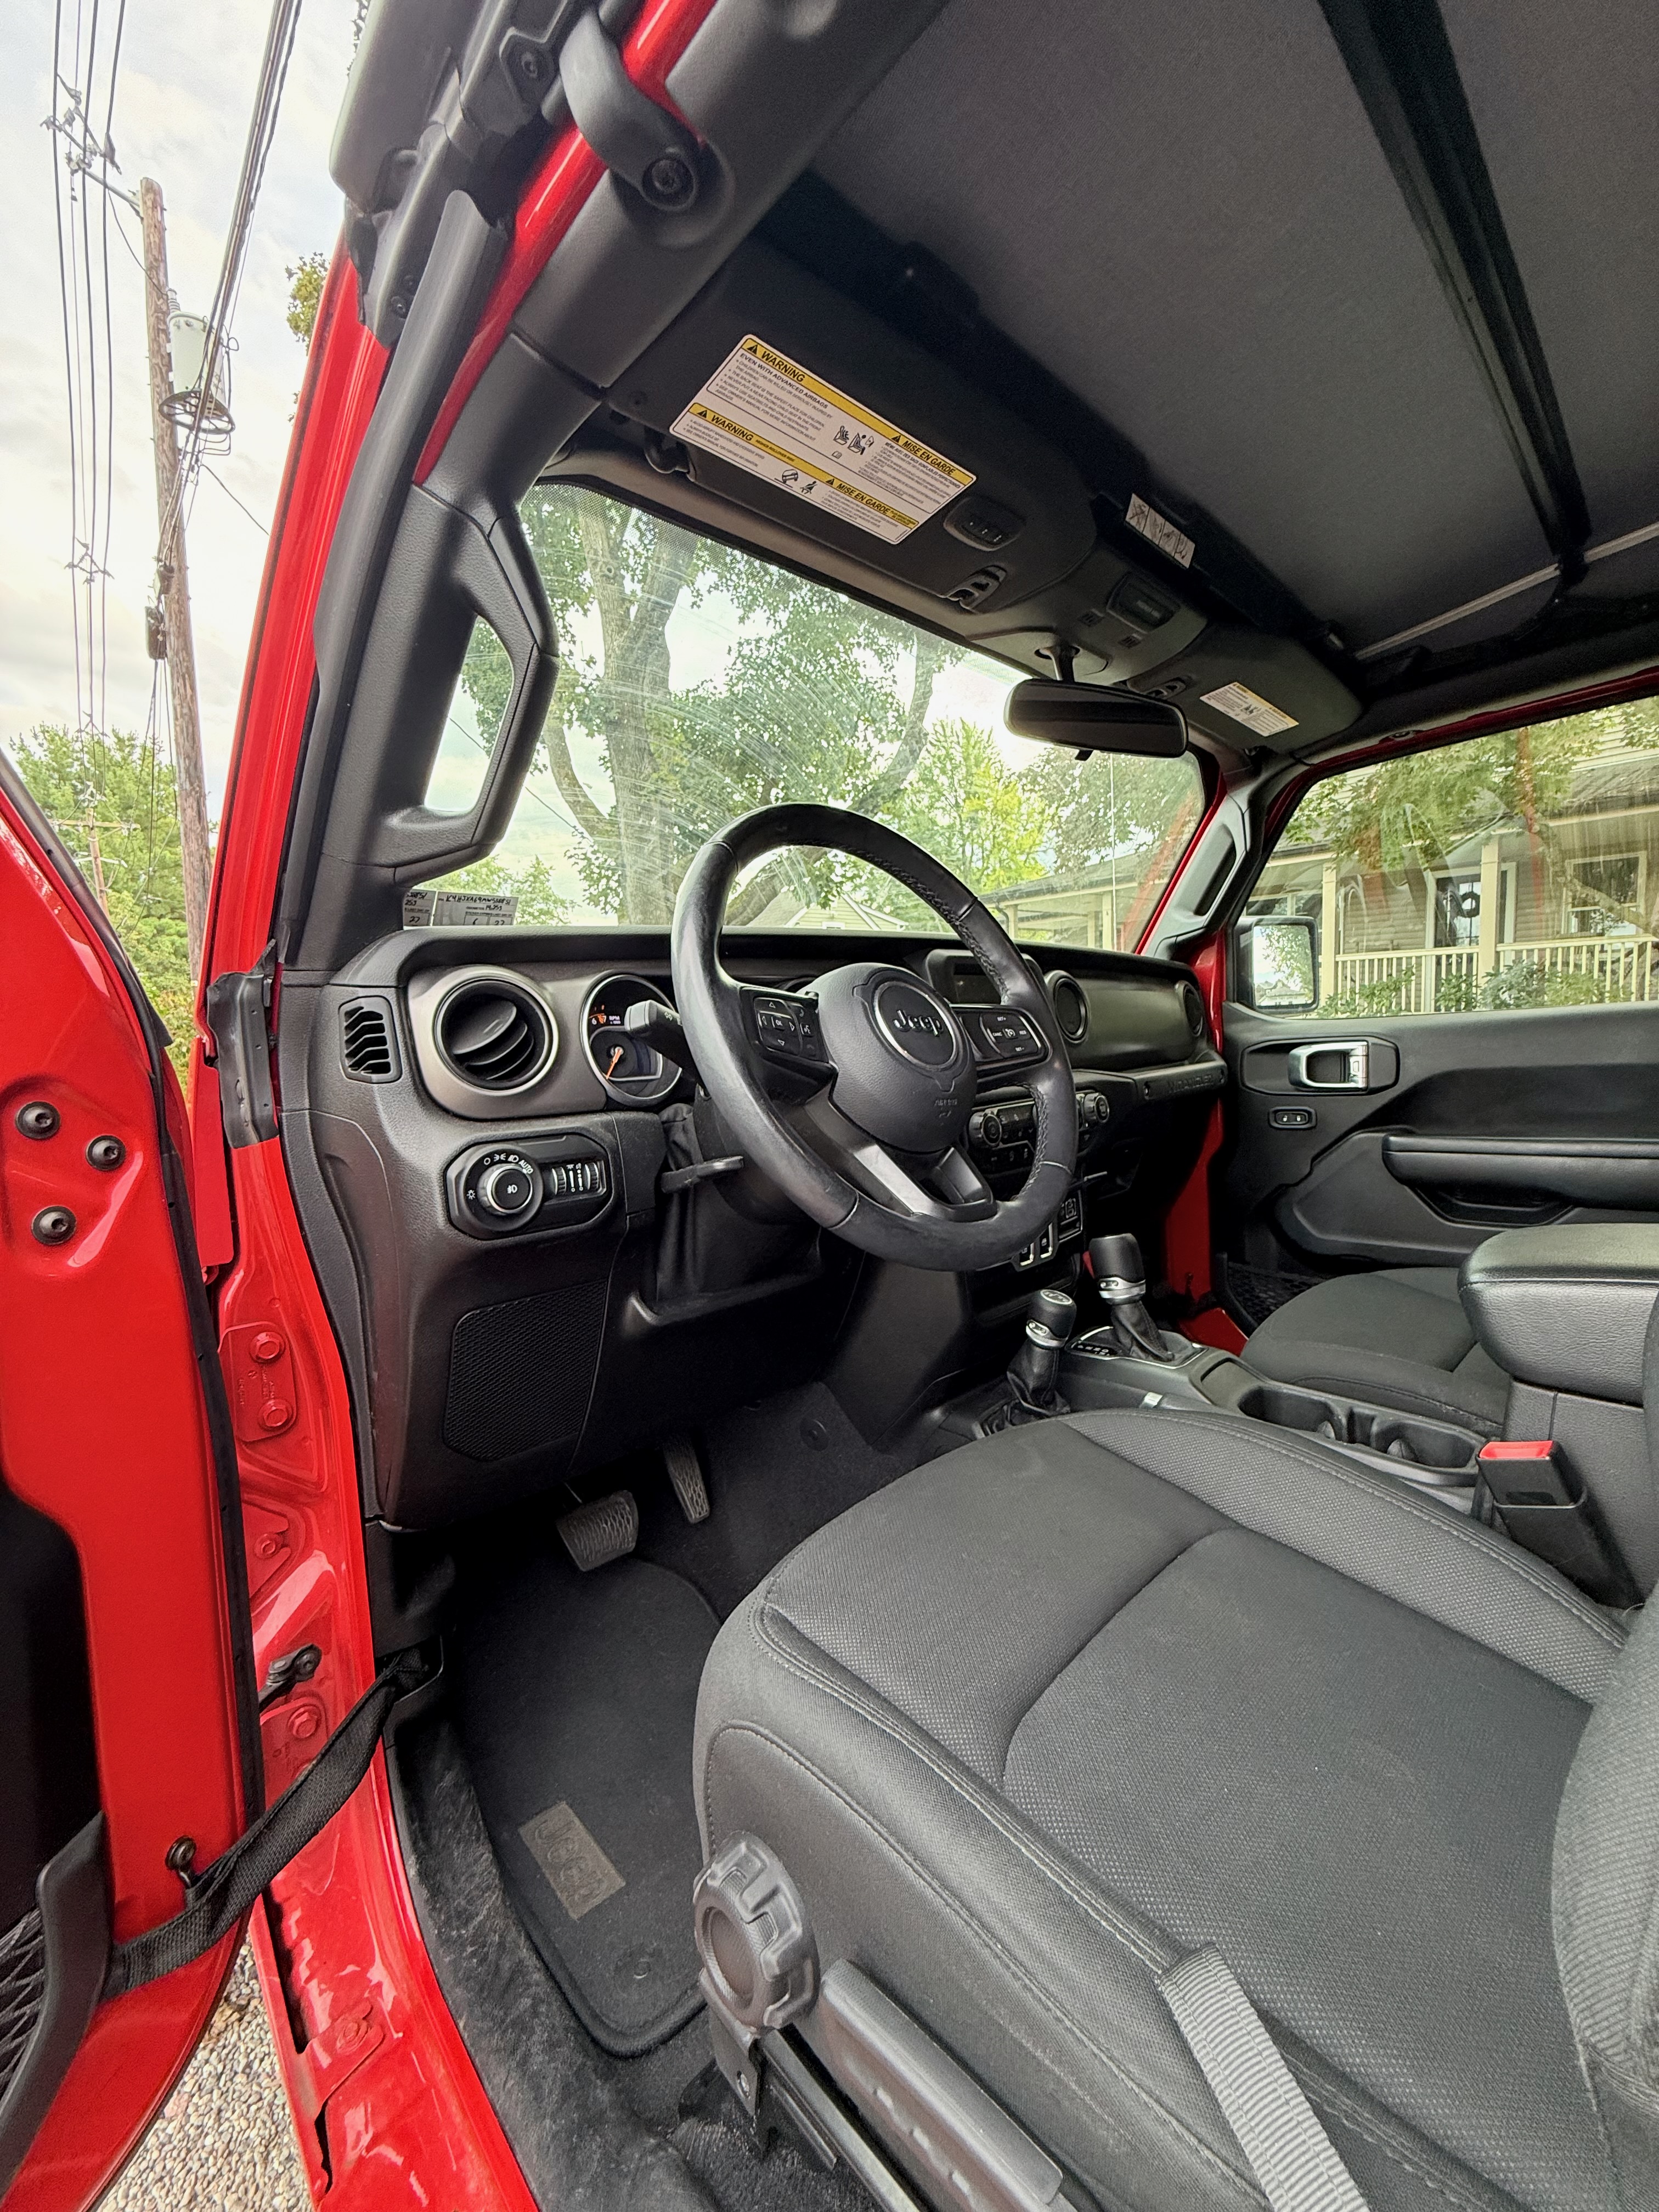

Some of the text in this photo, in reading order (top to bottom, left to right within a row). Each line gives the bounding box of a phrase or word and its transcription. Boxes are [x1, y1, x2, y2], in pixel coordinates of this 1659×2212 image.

[740, 353, 828, 408] EVEN WITH ADVANCED AIRBAGS
[761, 351, 805, 382] WARNING
[711, 415, 753, 441] WARNING
[901, 440, 956, 475] MISE EN GARDE
[836, 483, 856, 495] MISE
[854, 493, 866, 501] EN
[865, 499, 890, 514] GARDE
[892, 1008, 944, 1037] Jeep
[518, 1159, 534, 1174] AUTO
